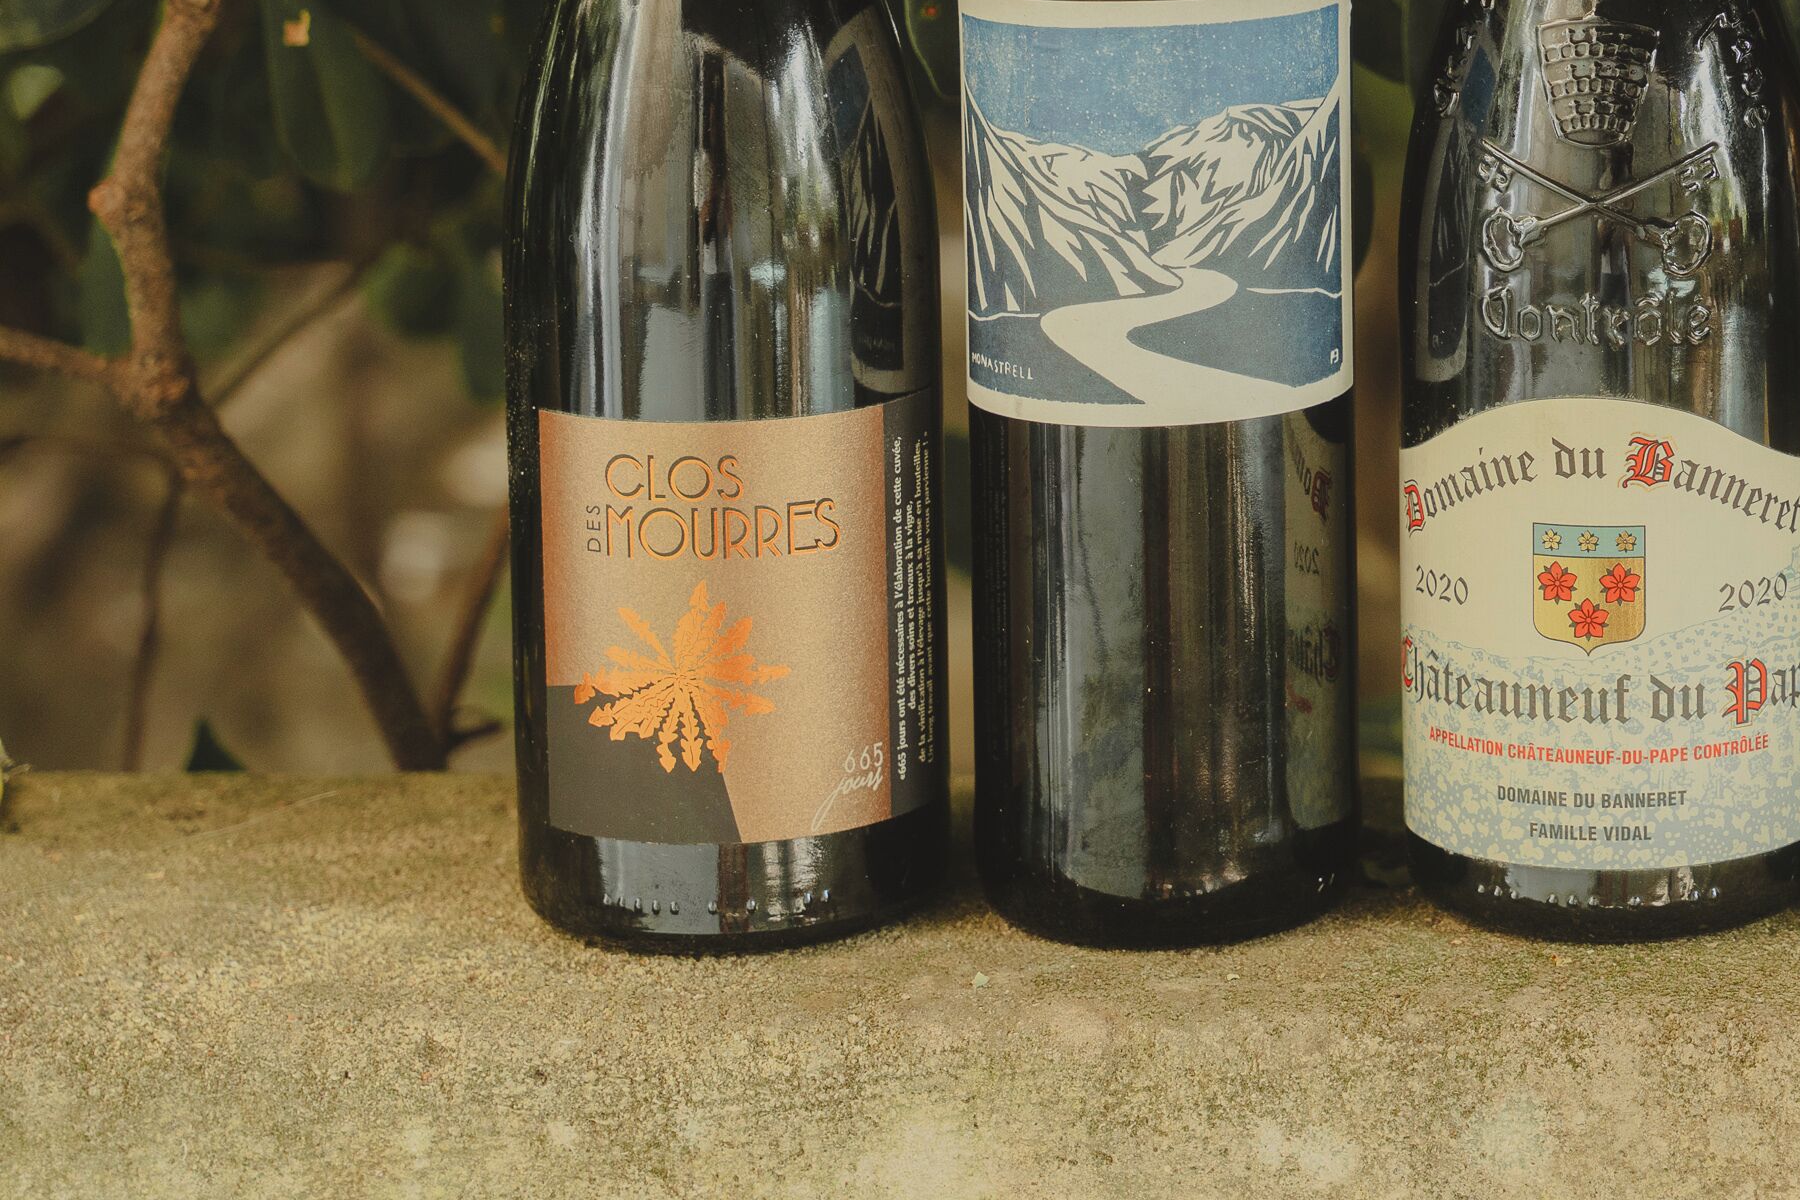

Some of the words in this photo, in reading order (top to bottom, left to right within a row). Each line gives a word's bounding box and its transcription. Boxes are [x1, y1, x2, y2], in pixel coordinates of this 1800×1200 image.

[971, 352, 1034, 380] MONASTRELL
[892, 436, 902, 474] cuvée,
[913, 439, 922, 498] bouteilles.
[605, 454, 744, 501] CLOS
[893, 476, 902, 506] cette
[1404, 447, 1538, 536] Domaine
[1551, 437, 1607, 479] du
[1622, 436, 1800, 534] Banneret
[893, 508, 902, 524] de
[905, 500, 915, 536] vigne,
[916, 500, 922, 515] en
[586, 504, 600, 552] DES
[606, 498, 841, 560] MOURRES
[915, 518, 923, 545] mise
[905, 538, 914, 550] la
[905, 551, 914, 560] à
[917, 547, 923, 560] sa
[893, 526, 904, 599] l'élaboration
[916, 562, 925, 604] jusqu'à
[1416, 564, 1469, 605] 2020
[1719, 572, 1788, 613] 2020
[894, 600, 904, 609] à
[907, 606, 915, 619] et
[895, 611, 905, 675] nécessaires
[907, 621, 915, 651] soins
[917, 606, 925, 656] l'élevage
[907, 652, 916, 688] divers
[917, 658, 925, 666] à
[896, 676, 906, 695] été
[1401, 631, 1631, 724] Châteauneuf
[1650, 674, 1707, 723] du
[897, 697, 906, 718] ont
[908, 689, 916, 710] des
[918, 668, 926, 732] vinification
[897, 720, 908, 750] jours
[918, 734, 926, 746] la
[1429, 726, 1503, 757] APPELLATION
[1508, 741, 1688, 766] CHÂTEAUNEUF-DU-PAPE
[1693, 731, 1769, 760] CONTRÔLÉE
[844, 741, 884, 773] 665
[918, 748, 926, 763] de
[1497, 785, 1567, 808] DOMAINE
[1573, 793, 1595, 809] DU
[1601, 790, 1687, 809] BANNERET
[1529, 822, 1597, 841] FAMILLE
[1604, 826, 1652, 841] VIDAL
